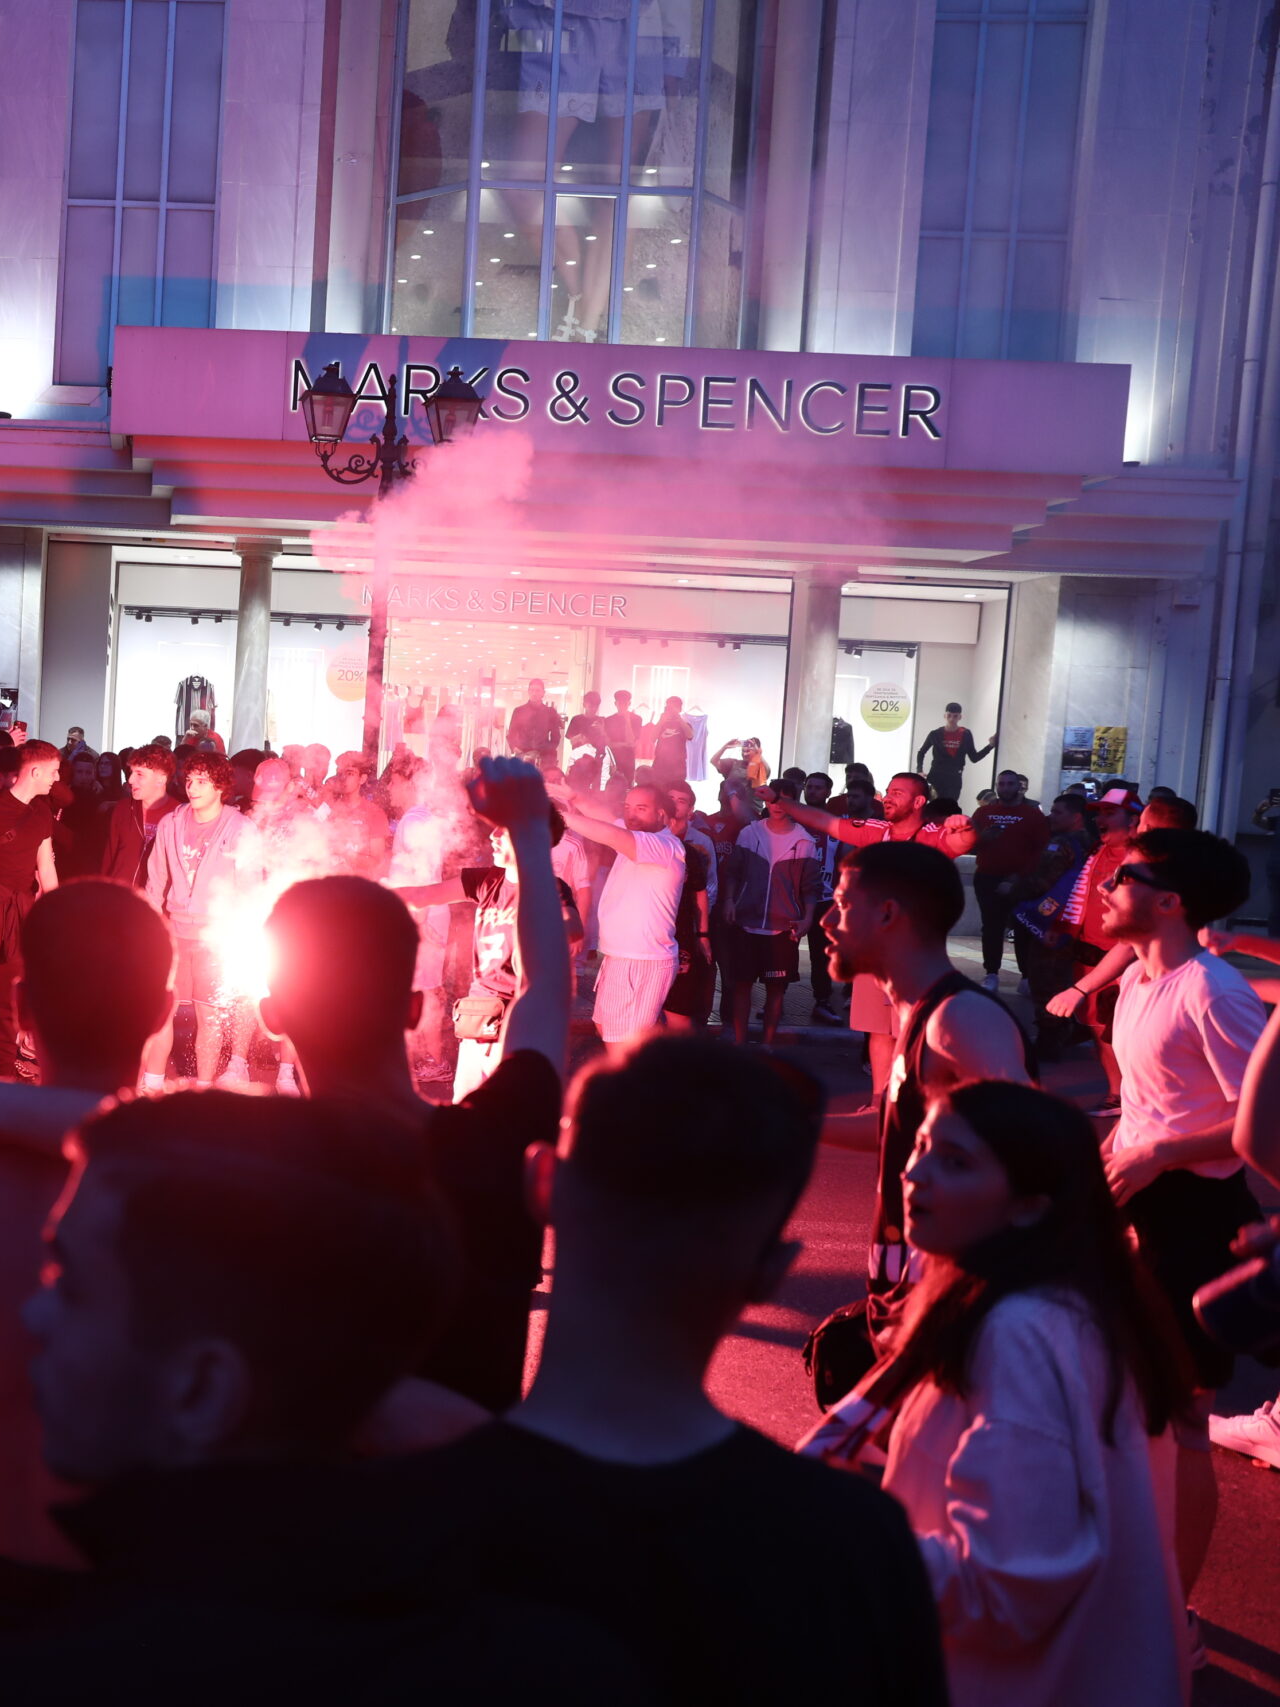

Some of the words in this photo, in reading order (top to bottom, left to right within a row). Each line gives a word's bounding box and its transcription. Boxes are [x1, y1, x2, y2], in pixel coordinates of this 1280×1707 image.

[548, 370, 591, 424] &
[606, 371, 942, 439] SPENCER
[466, 590, 485, 613] &
[491, 590, 628, 619] SPENCER
[336, 669, 365, 682] 20%
[871, 699, 900, 712] 20%
[988, 814, 1024, 822] TOMMY
